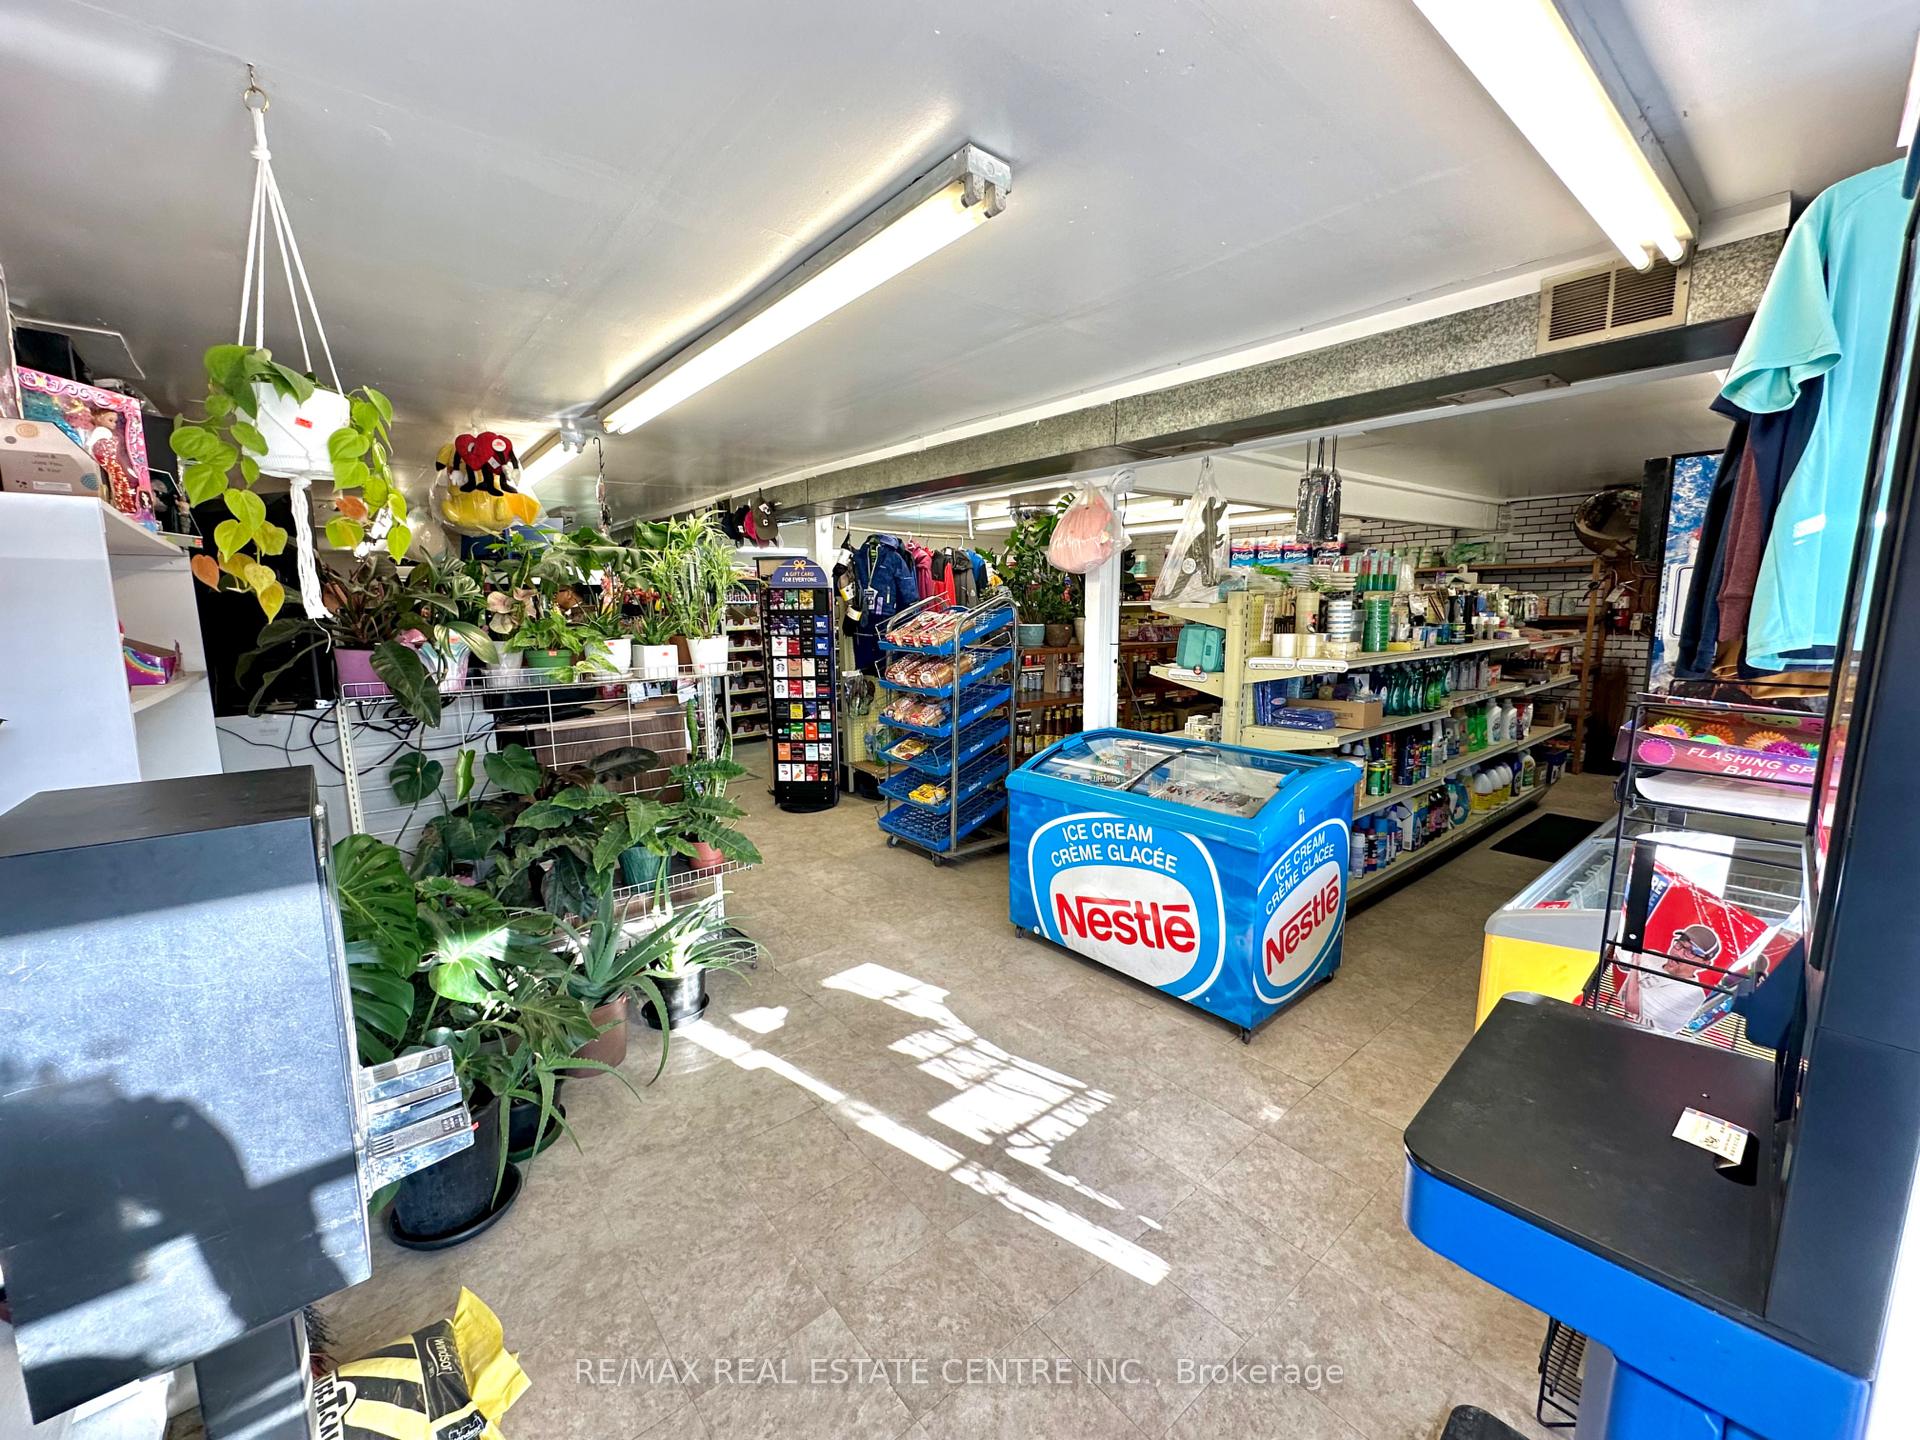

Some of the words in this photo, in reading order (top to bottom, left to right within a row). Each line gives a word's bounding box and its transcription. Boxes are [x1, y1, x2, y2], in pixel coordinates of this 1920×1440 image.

[1687, 747, 1783, 770] FLASHING
[1051, 842, 1103, 867] CRÈME
[1107, 844, 1178, 874] GLACÉE
[1062, 823, 1088, 842] ICE
[1091, 822, 1153, 844] CREAM
[1274, 858, 1292, 884] ICE
[1293, 830, 1326, 865] CREAM
[1265, 868, 1300, 915] CRÈME
[1301, 842, 1335, 875] GLACÉE
[1055, 893, 1196, 953] Nestlé
[1266, 874, 1339, 976] Nestlé
